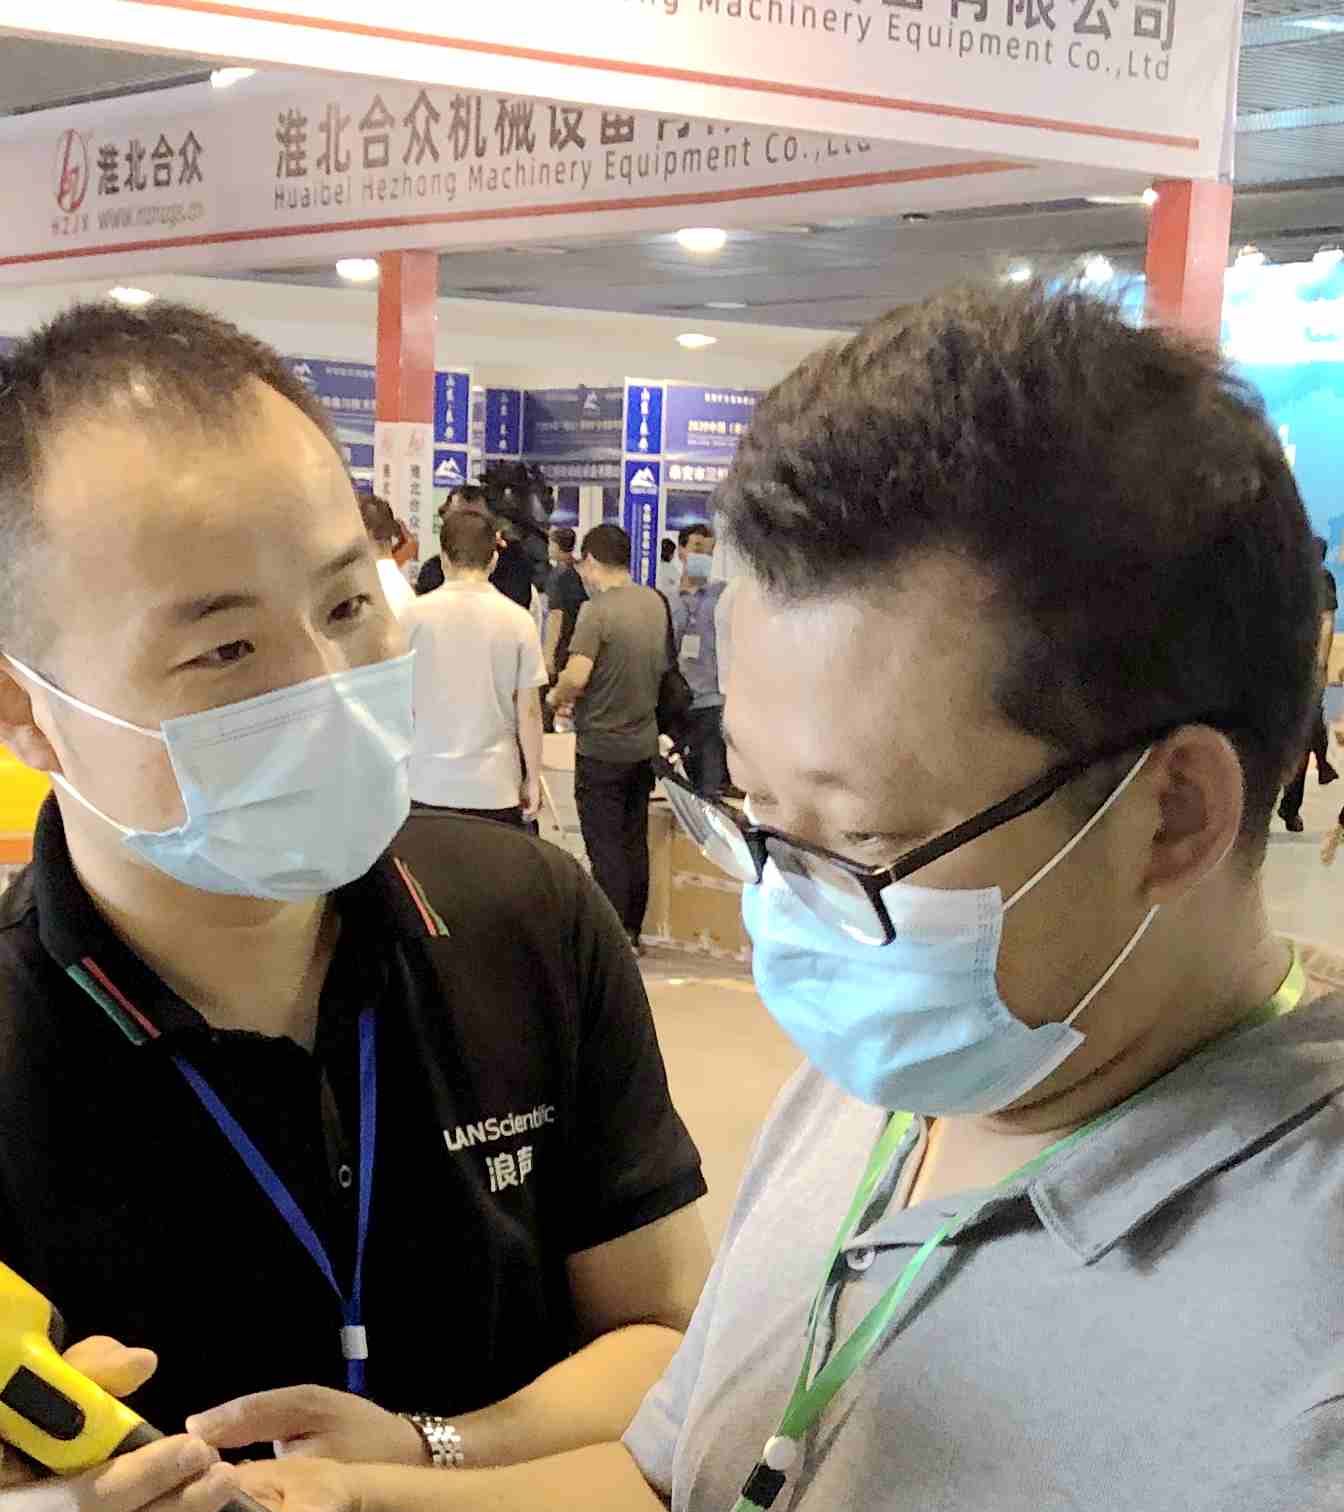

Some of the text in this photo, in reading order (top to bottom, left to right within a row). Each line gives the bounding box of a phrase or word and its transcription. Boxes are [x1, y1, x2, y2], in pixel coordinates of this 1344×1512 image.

[887, 13, 1054, 64] Equipment
[467, 157, 593, 192] Machinery
[604, 136, 753, 184] Equipment
[442, 1103, 556, 1152] LANScientic
